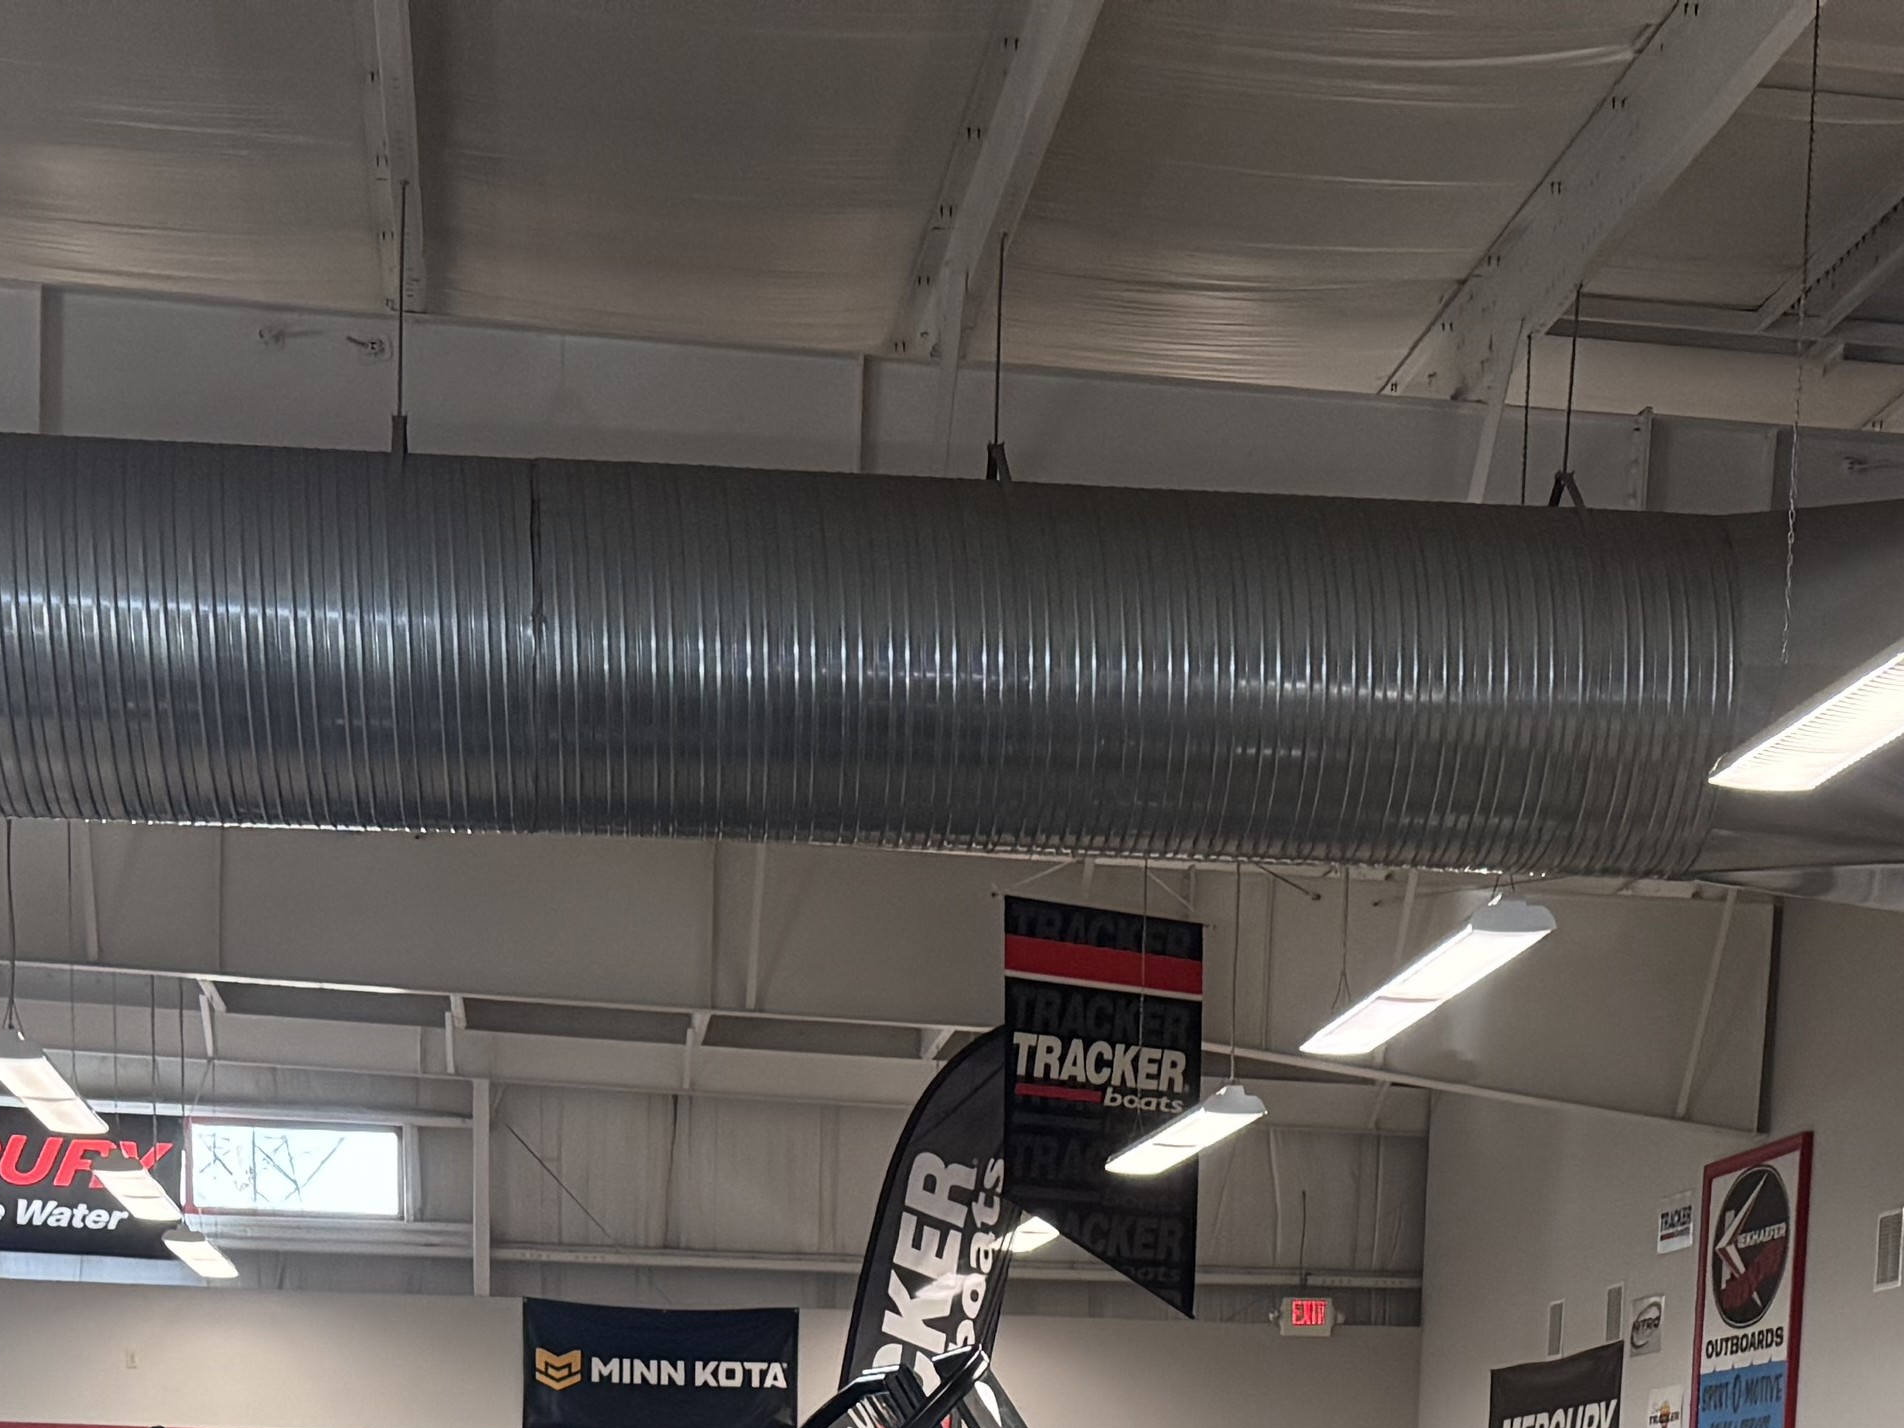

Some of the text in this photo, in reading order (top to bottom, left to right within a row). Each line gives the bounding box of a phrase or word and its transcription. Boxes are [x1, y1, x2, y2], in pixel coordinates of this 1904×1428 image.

[1013, 1032, 1187, 1093] TRACKER
[1104, 1087, 1185, 1114] boats
[16, 1199, 130, 1231] Water
[1292, 1299, 1328, 1325] EXIT
[1705, 1325, 1785, 1359] OUTBOARDS
[591, 1356, 787, 1390] MINN KOTA
